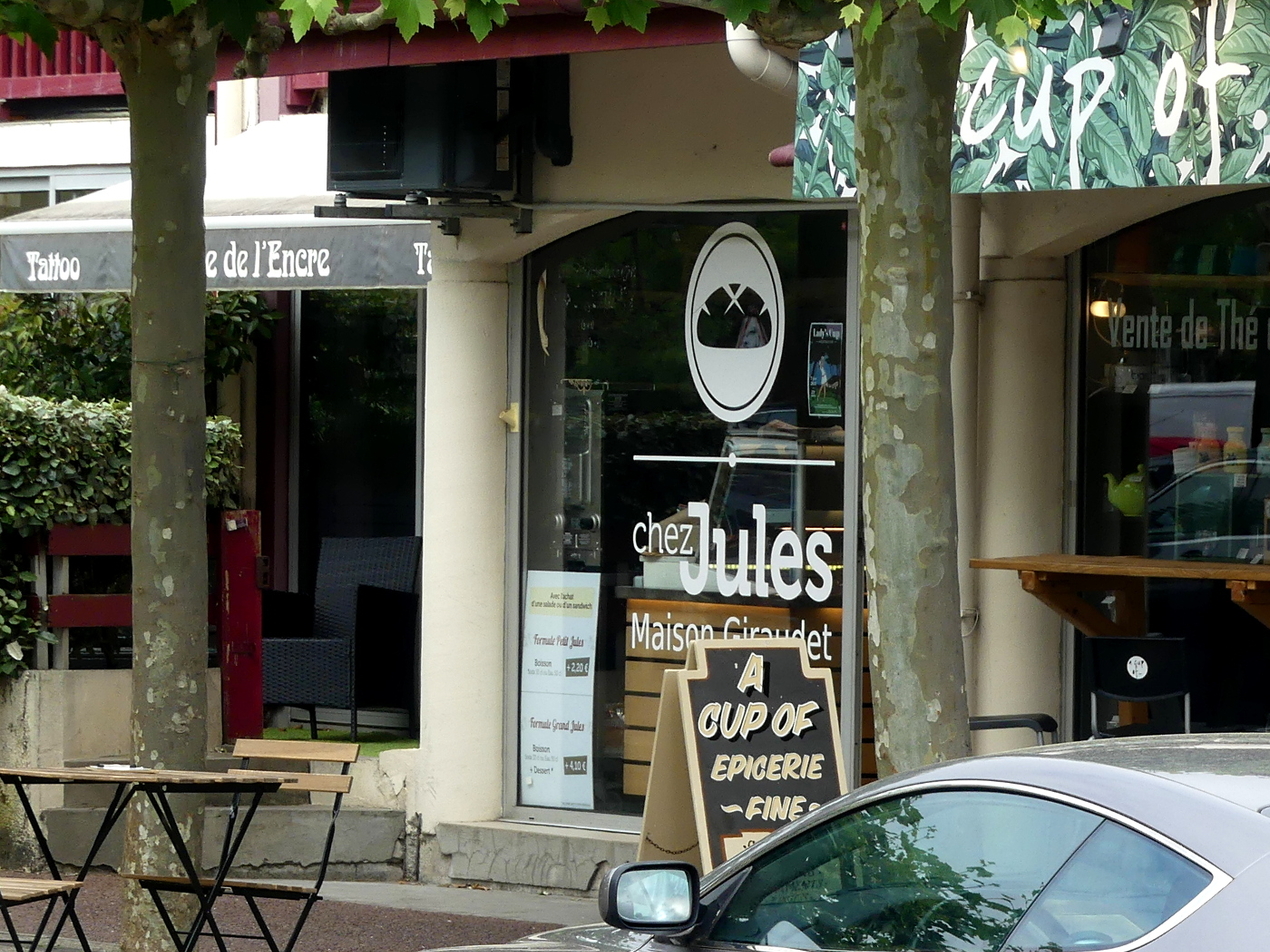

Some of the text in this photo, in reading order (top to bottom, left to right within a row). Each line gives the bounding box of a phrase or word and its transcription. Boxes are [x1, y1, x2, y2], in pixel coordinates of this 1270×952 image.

[960, 56, 1116, 190] cup
[25, 251, 80, 282] Tattoo
[223, 241, 249, 278] de
[252, 240, 331, 278] l'Encre
[1108, 298, 1172, 348] Vente
[1181, 298, 1209, 349] de
[1216, 298, 1258, 350] Thé
[632, 502, 833, 602] chez Jules
[531, 600, 543, 608] d'une
[562, 601, 572, 609] d'un
[572, 602, 592, 610] sandwich
[550, 592, 560, 600] Avec
[534, 634, 584, 649] Formule Petit Jules
[631, 613, 713, 652] Maison
[534, 659, 552, 667] Boisson
[737, 652, 765, 695] A
[530, 717, 584, 733] Formule Grand Jules
[697, 700, 820, 740] CUP OF
[532, 744, 551, 753] Boisson
[533, 766, 551, 775] Dessert
[711, 752, 825, 782] EPICERIE
